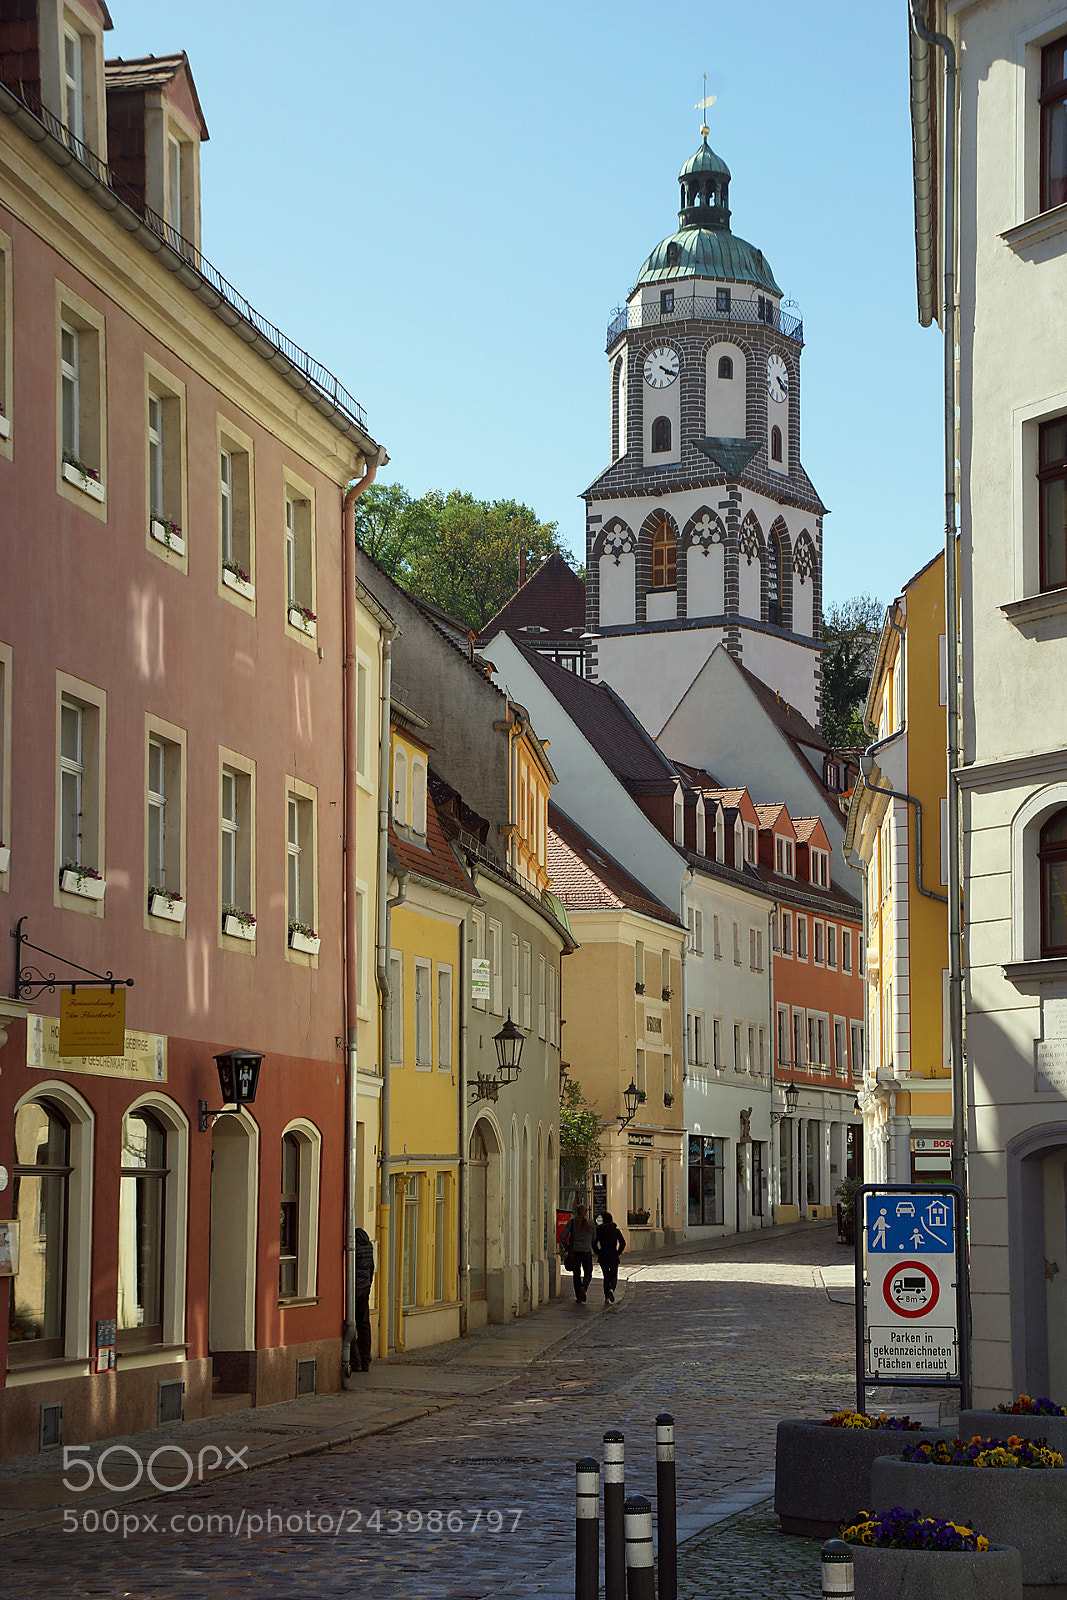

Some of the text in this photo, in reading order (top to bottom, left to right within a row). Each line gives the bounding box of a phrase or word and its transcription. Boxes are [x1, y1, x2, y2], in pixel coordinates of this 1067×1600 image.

[905, 1295, 918, 1303] 8m
[890, 1331, 934, 1343] Parken in
[873, 1344, 952, 1358] gekennzeichneten
[877, 1357, 948, 1370] Flächen erlaubt
